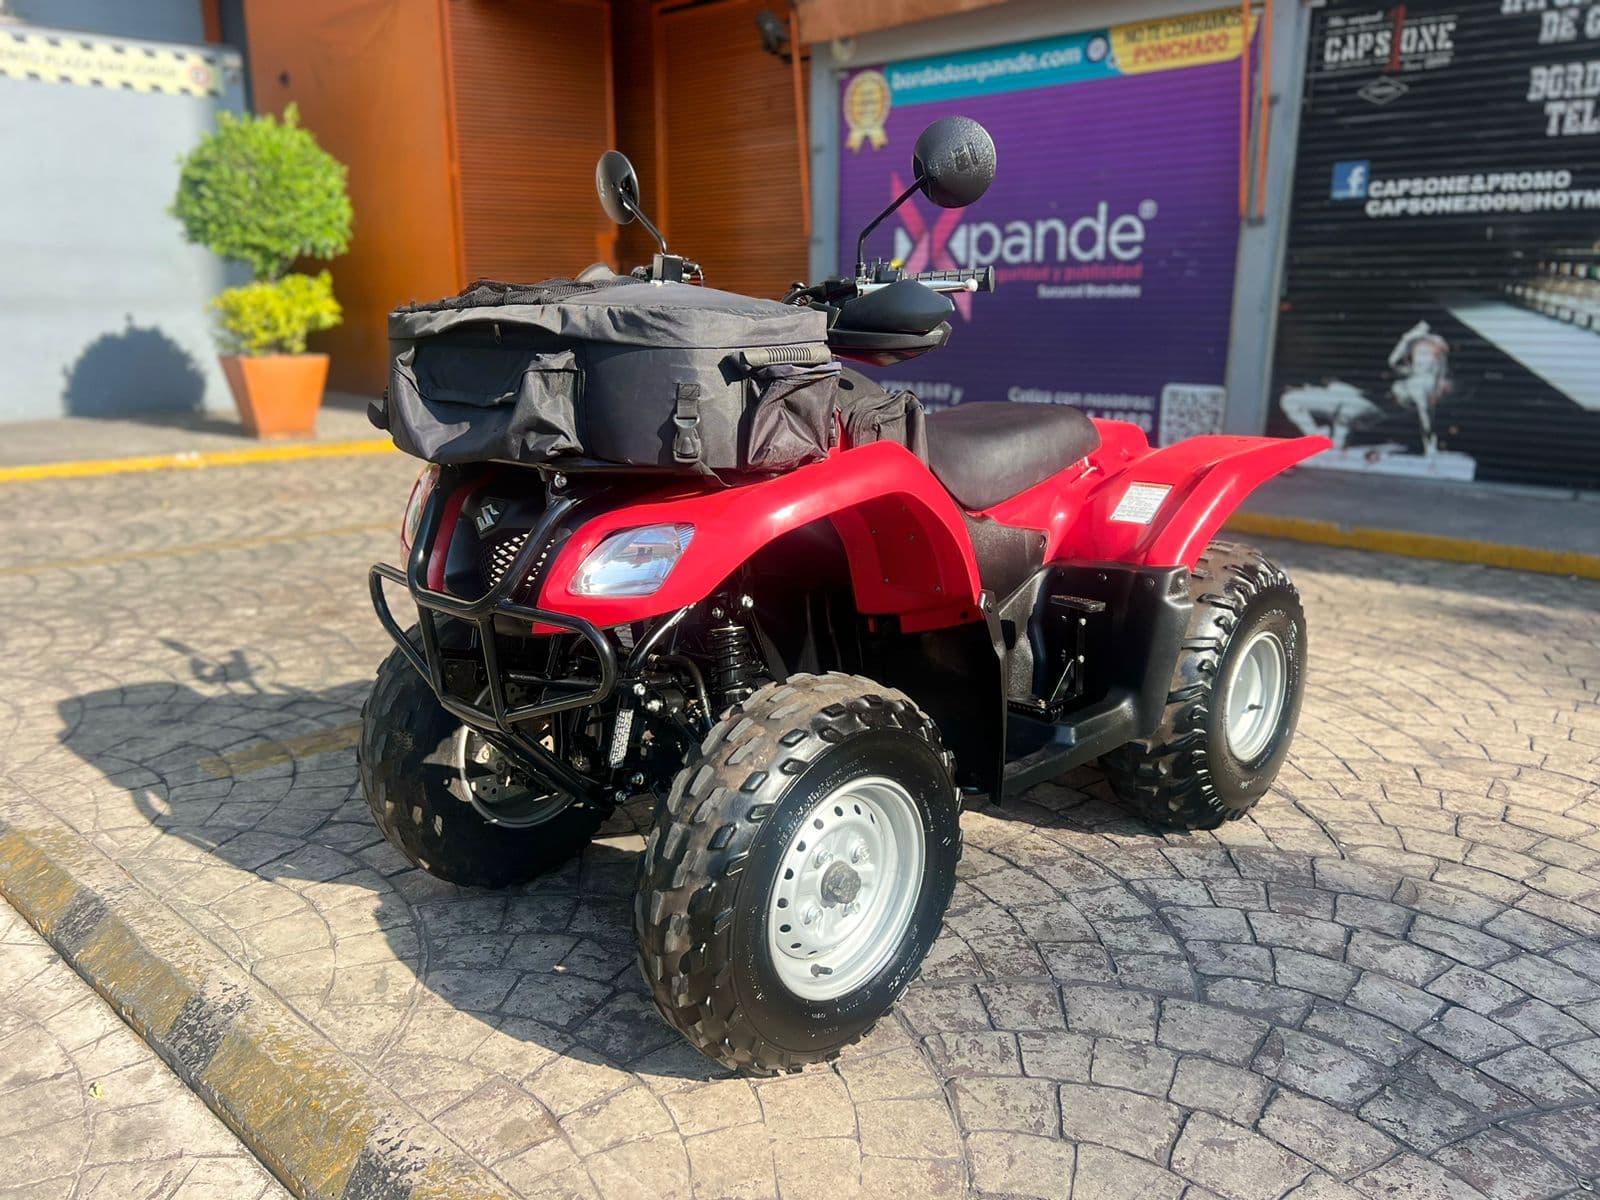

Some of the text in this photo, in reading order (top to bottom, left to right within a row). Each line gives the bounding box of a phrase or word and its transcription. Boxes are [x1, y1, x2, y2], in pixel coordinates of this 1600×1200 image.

[1538, 9, 1580, 45] DE
[1133, 32, 1230, 64] PONCHADO
[891, 46, 1083, 91] bordadosxpande.com
[1367, 169, 1572, 199] CAPSONE&PROMO
[1054, 391, 1081, 405] con
